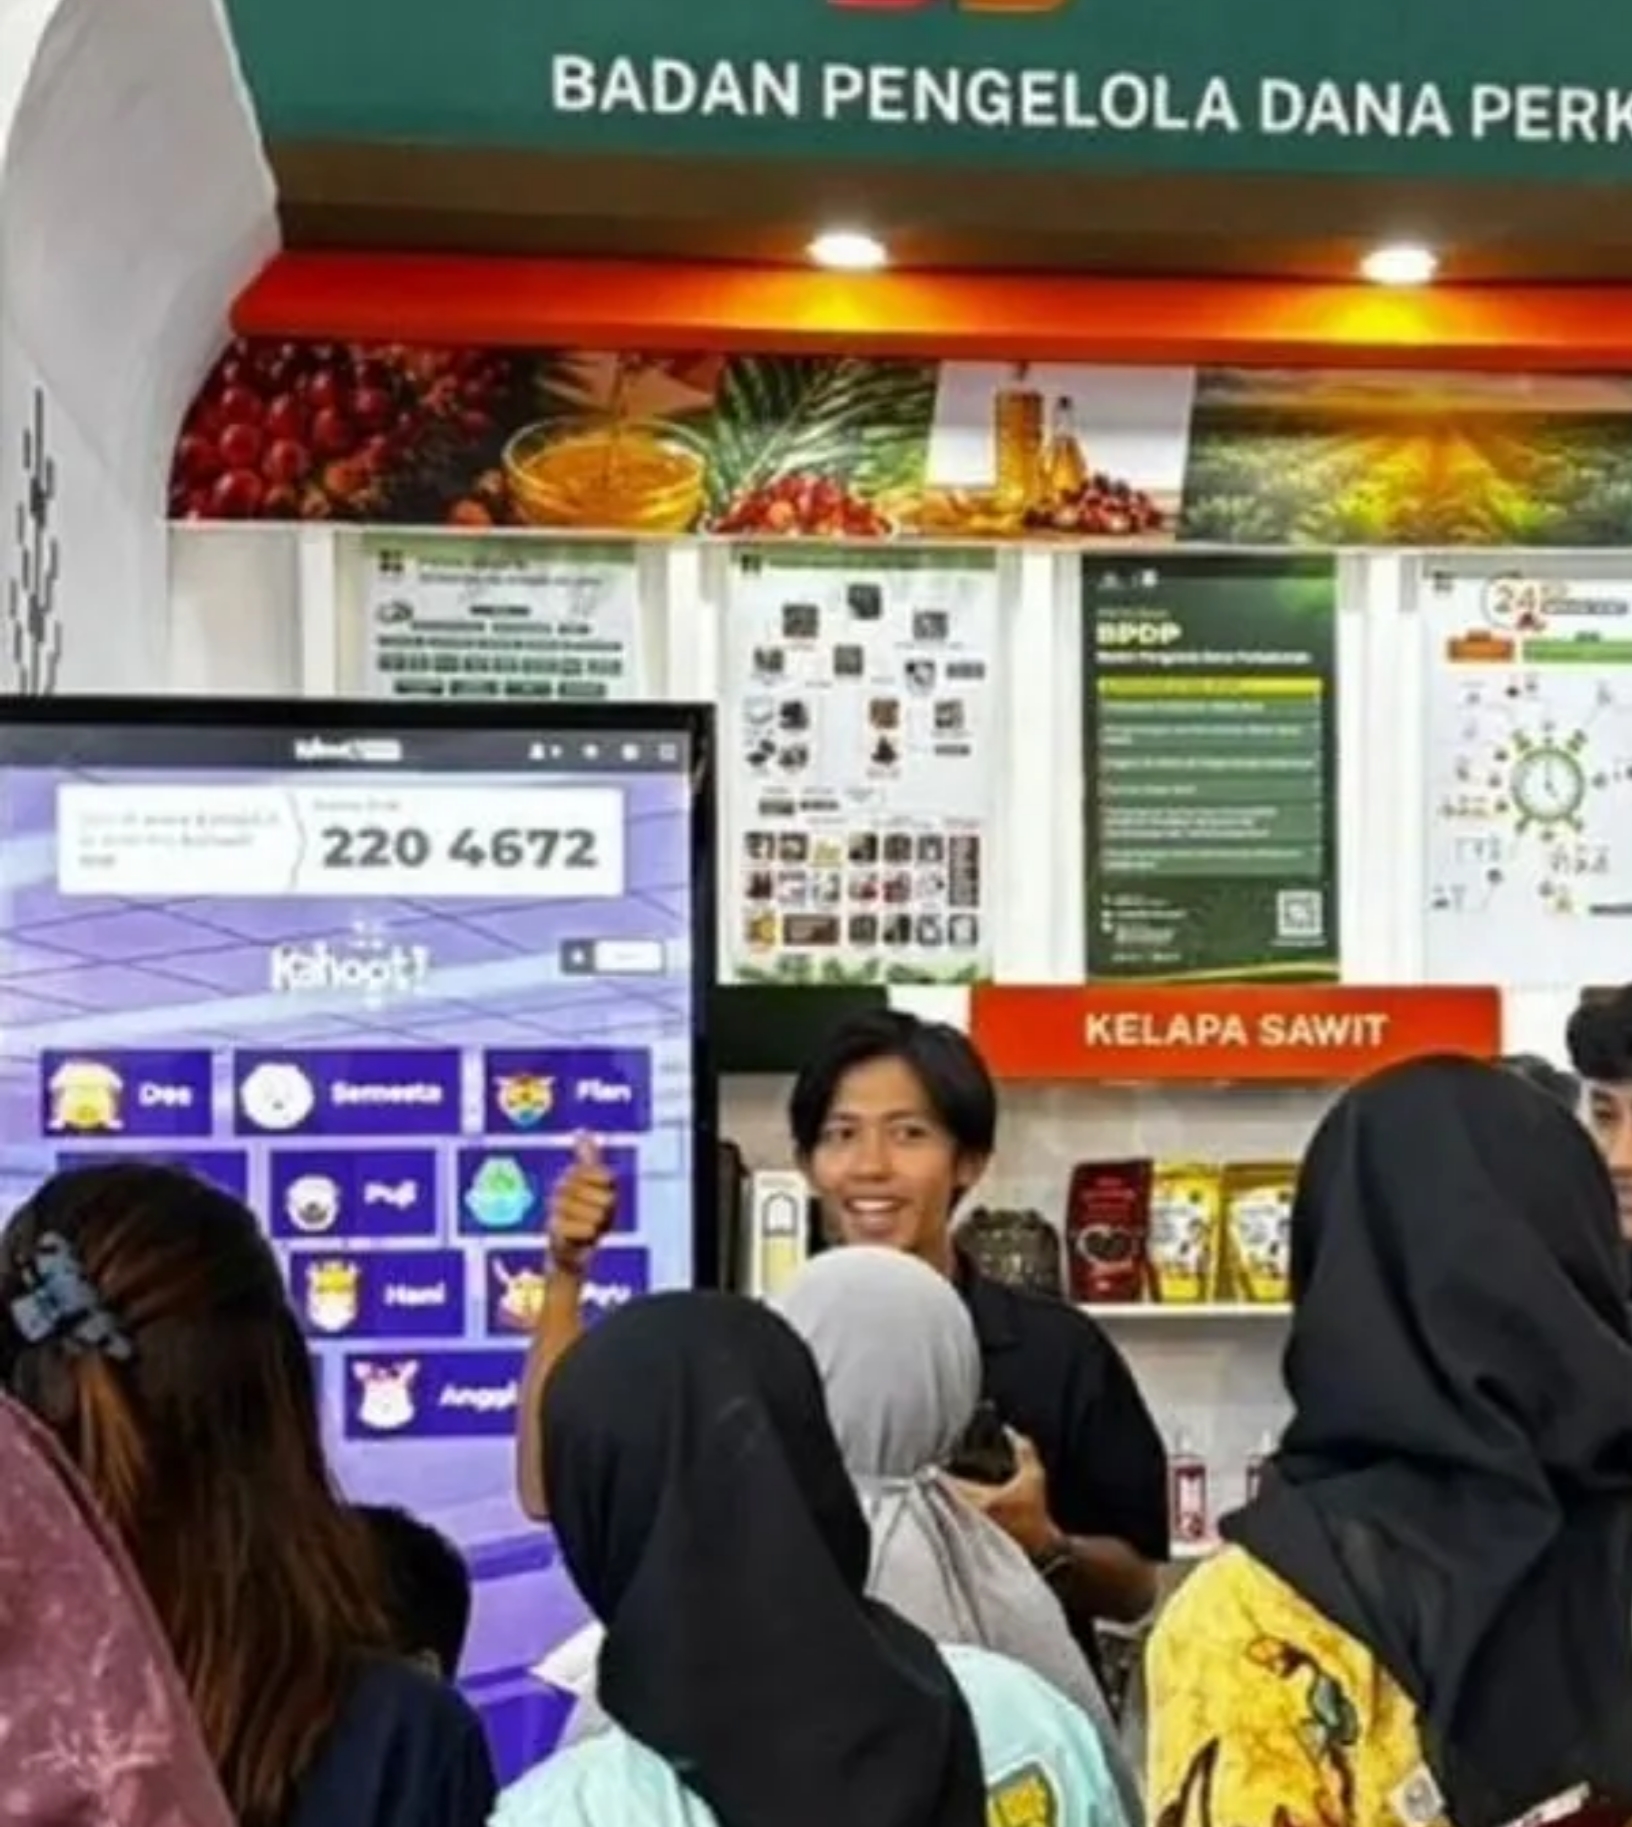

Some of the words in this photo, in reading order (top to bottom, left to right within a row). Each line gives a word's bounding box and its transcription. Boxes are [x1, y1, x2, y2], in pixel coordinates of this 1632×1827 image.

[551, 54, 801, 118] BADAN
[821, 64, 1240, 133] PENGELOLA
[1260, 78, 1453, 138] DANA
[1095, 621, 1182, 645] BPDP
[322, 825, 431, 869] 220
[447, 827, 598, 869] 4672
[1084, 1012, 1249, 1047] KELAPA
[1259, 1013, 1389, 1047] SAWIT
[330, 1080, 443, 1105] Semesta
